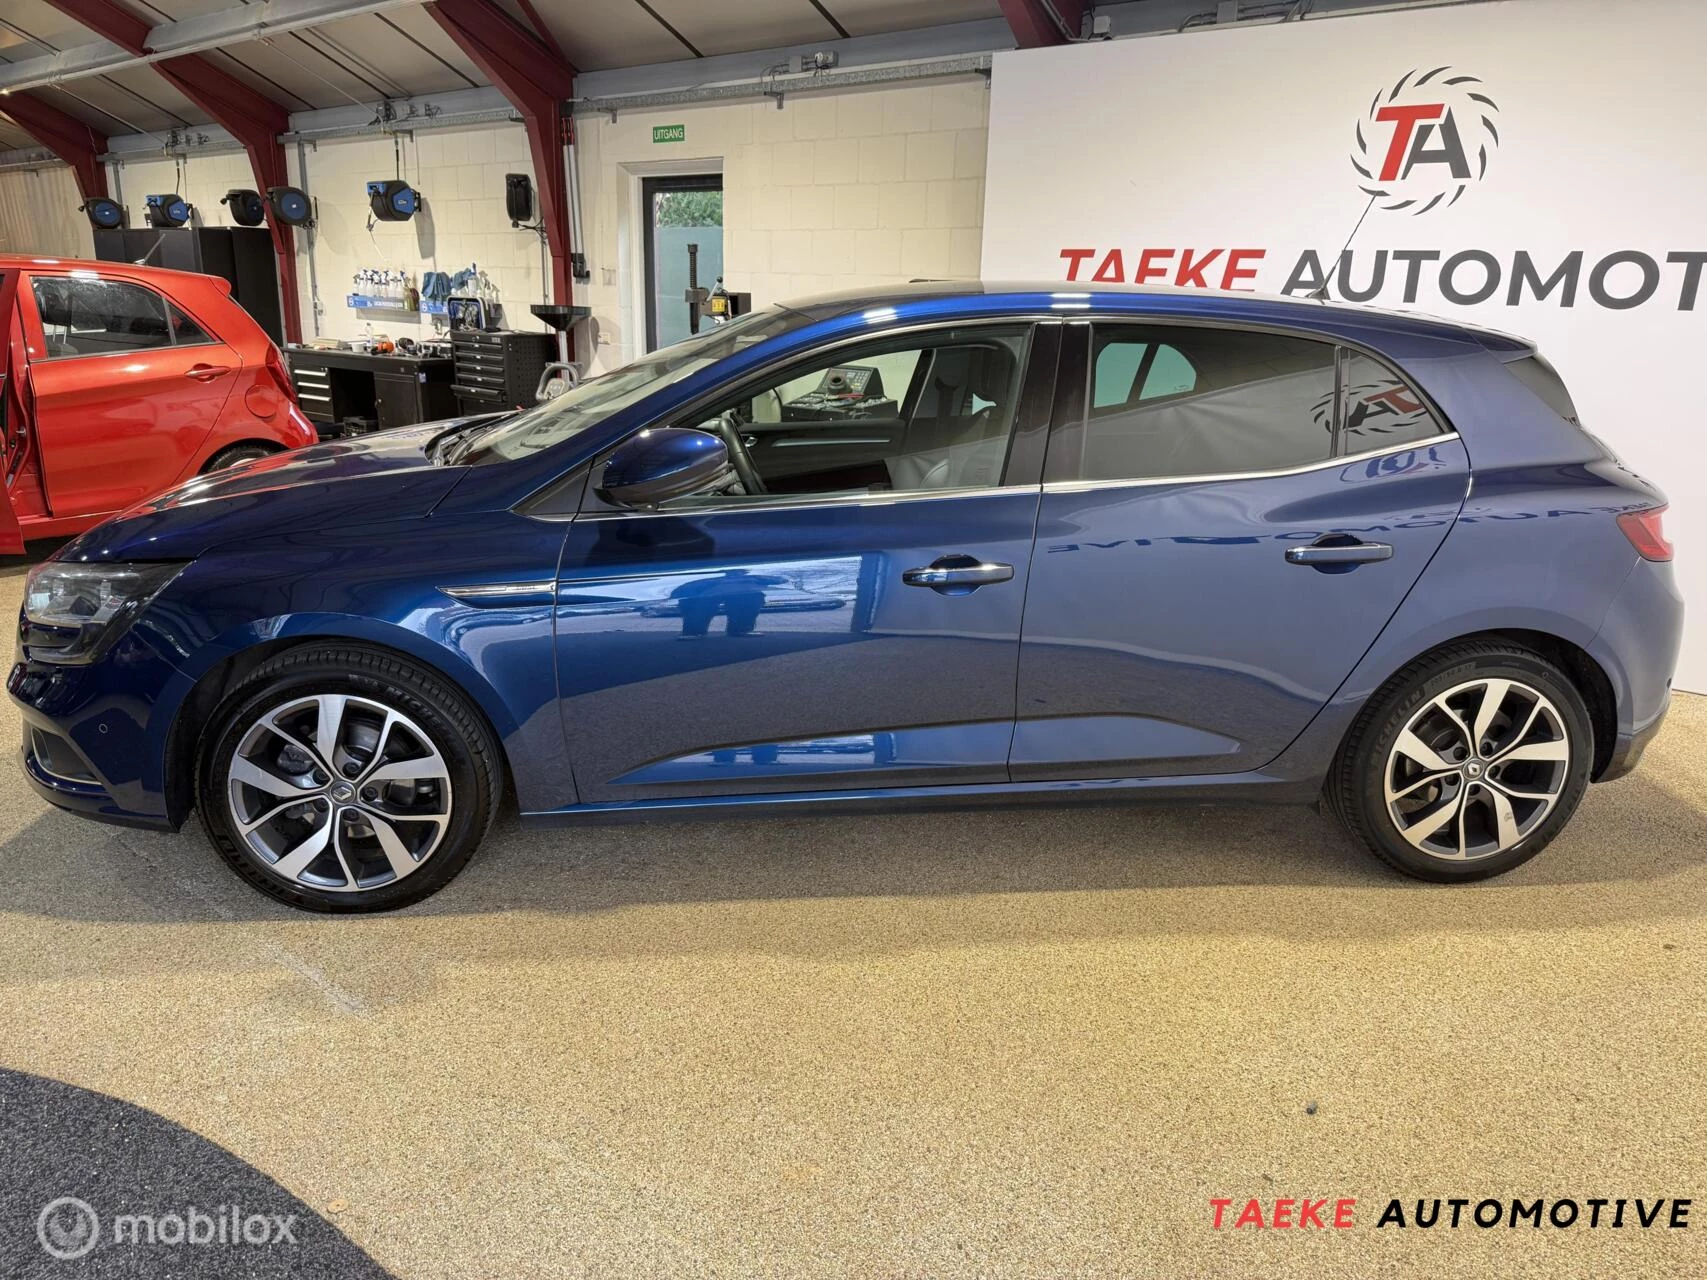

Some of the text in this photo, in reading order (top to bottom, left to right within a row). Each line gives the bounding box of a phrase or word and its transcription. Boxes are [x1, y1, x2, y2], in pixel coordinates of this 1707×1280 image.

[653, 127, 684, 141] UITGANG
[1375, 103, 1472, 182] TA
[1059, 248, 1707, 312] TAEKE AUTOMOT
